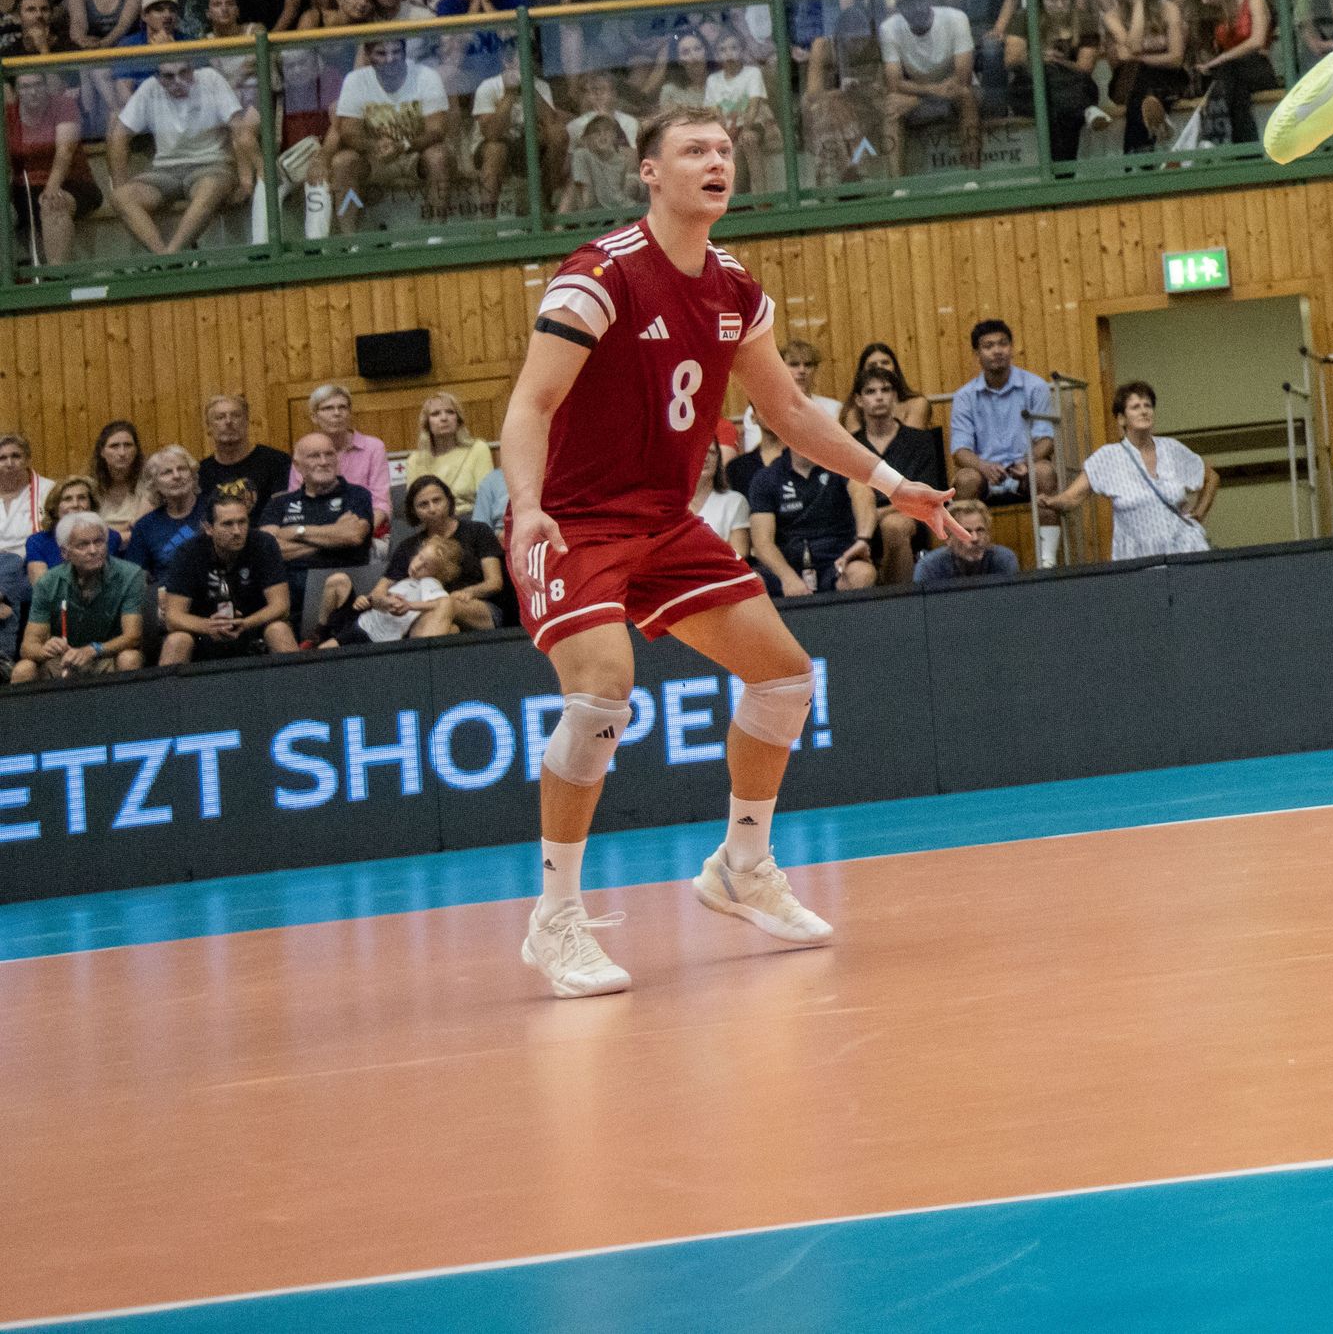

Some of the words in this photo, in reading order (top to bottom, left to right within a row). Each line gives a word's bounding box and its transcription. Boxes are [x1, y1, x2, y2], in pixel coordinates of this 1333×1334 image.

[721, 330, 740, 340] AUT
[668, 359, 703, 432] 8
[549, 579, 566, 602] 8
